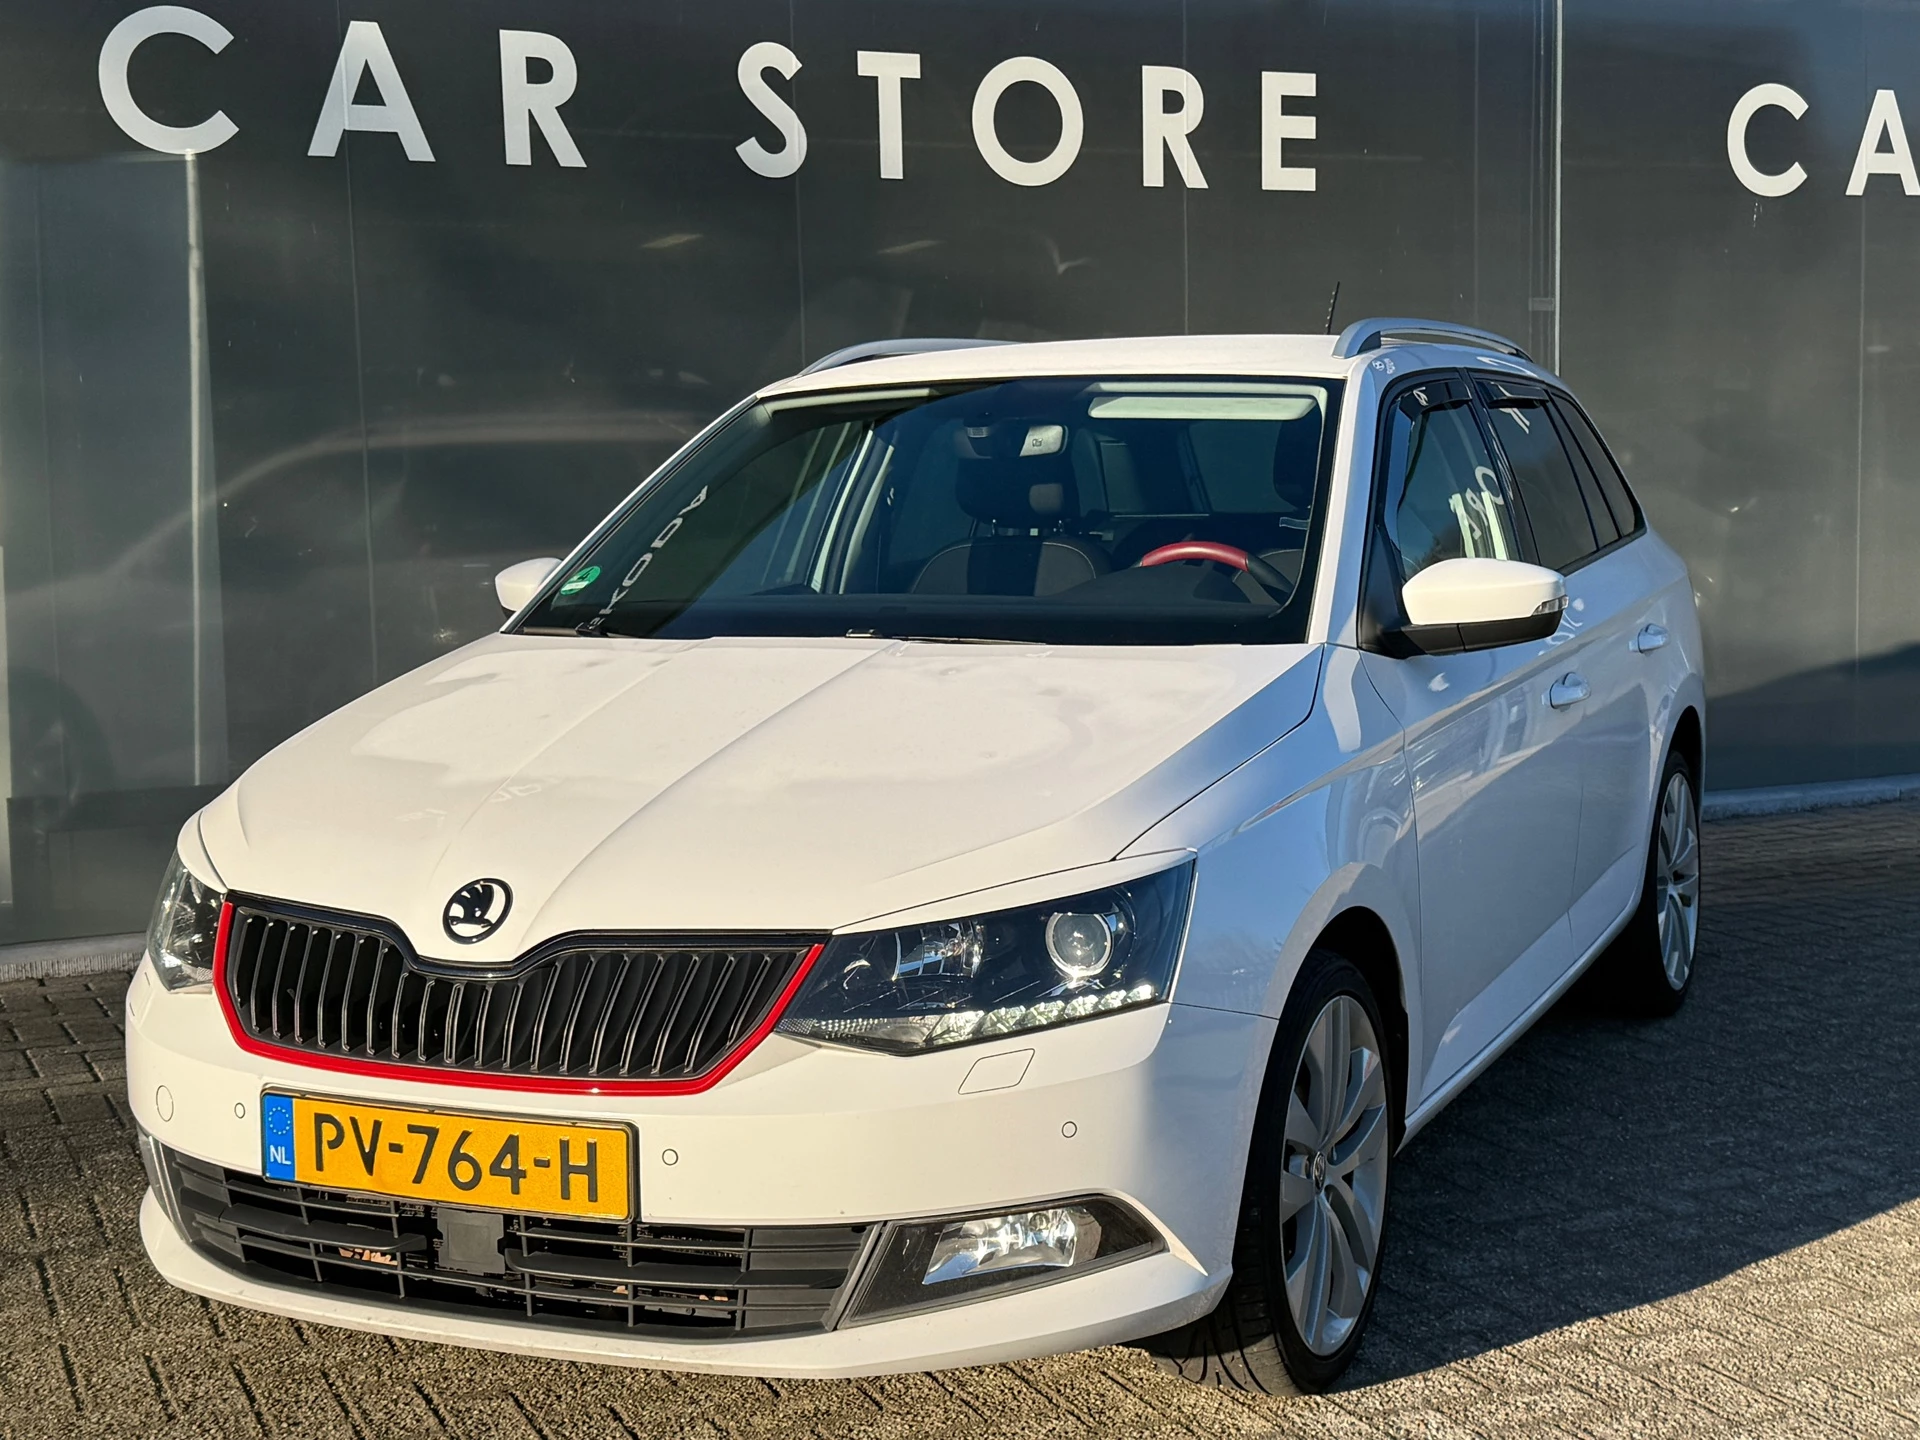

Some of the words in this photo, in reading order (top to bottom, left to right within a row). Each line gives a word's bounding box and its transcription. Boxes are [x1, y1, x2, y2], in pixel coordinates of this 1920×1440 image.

[98, 5, 588, 168] CAR
[735, 41, 1318, 192] STORE
[1726, 82, 1920, 198] CA
[269, 1144, 292, 1165] NL
[313, 1111, 599, 1203] PV-764-H
